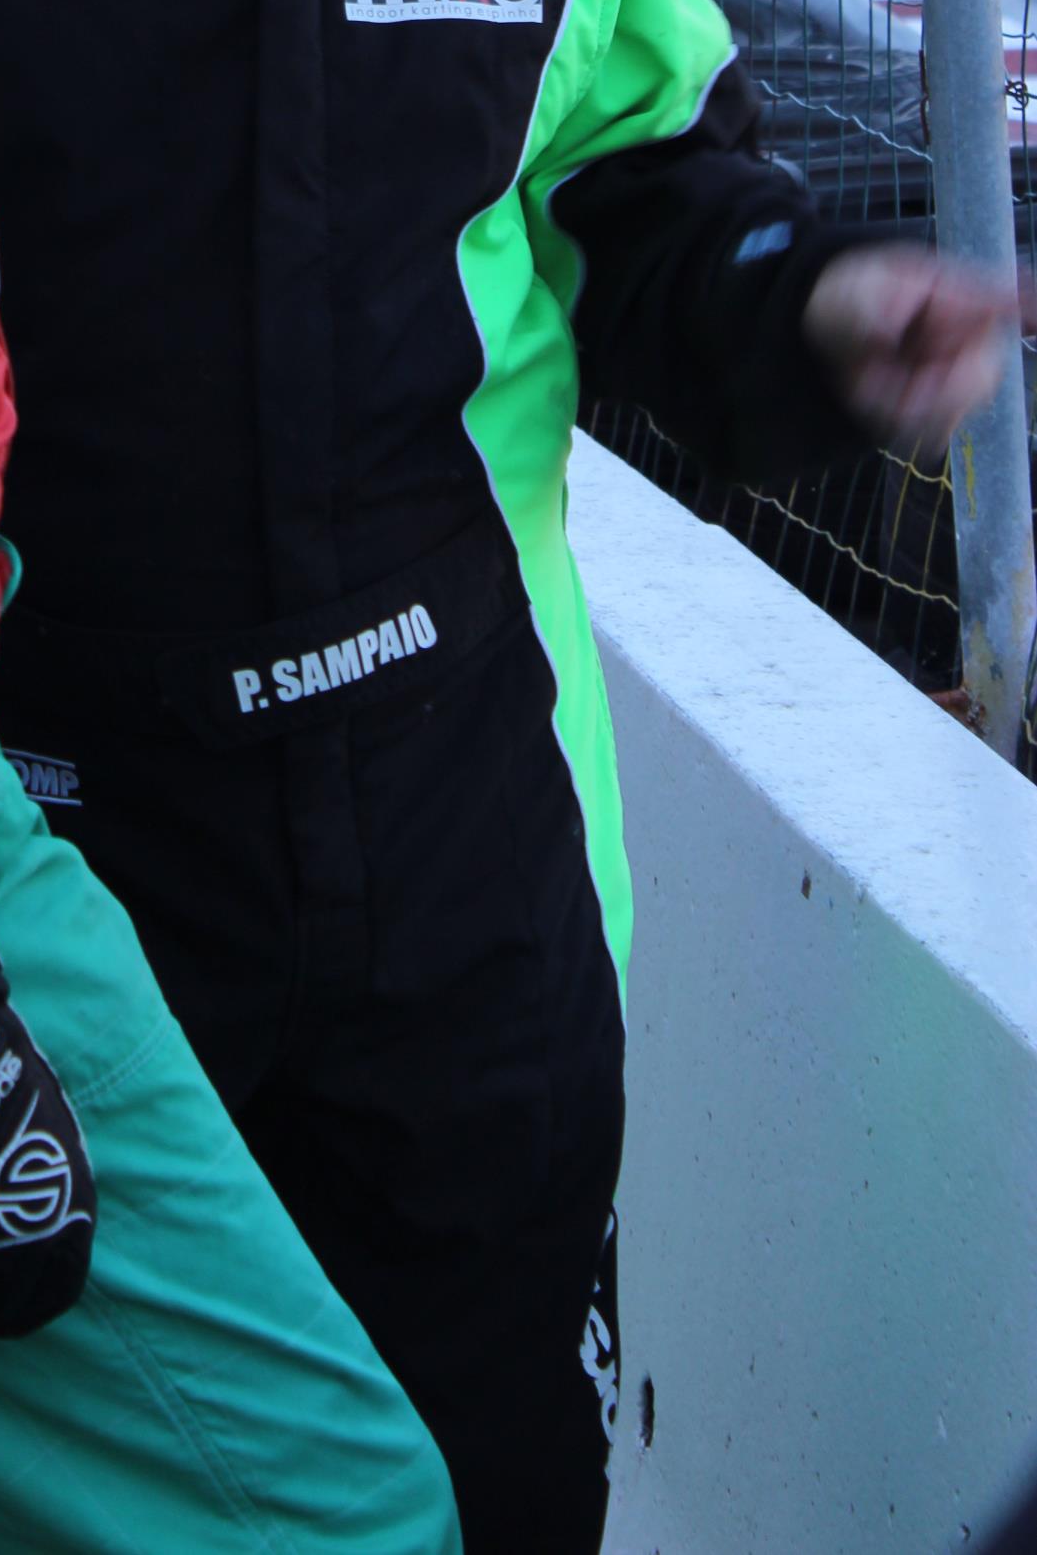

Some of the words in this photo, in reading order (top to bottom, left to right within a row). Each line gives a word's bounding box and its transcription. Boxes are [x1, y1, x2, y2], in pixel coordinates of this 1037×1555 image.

[350, 6, 406, 19] indoor
[410, 4, 473, 18] karting
[232, 669, 269, 713] P.
[271, 604, 437, 702] SAMPAIO
